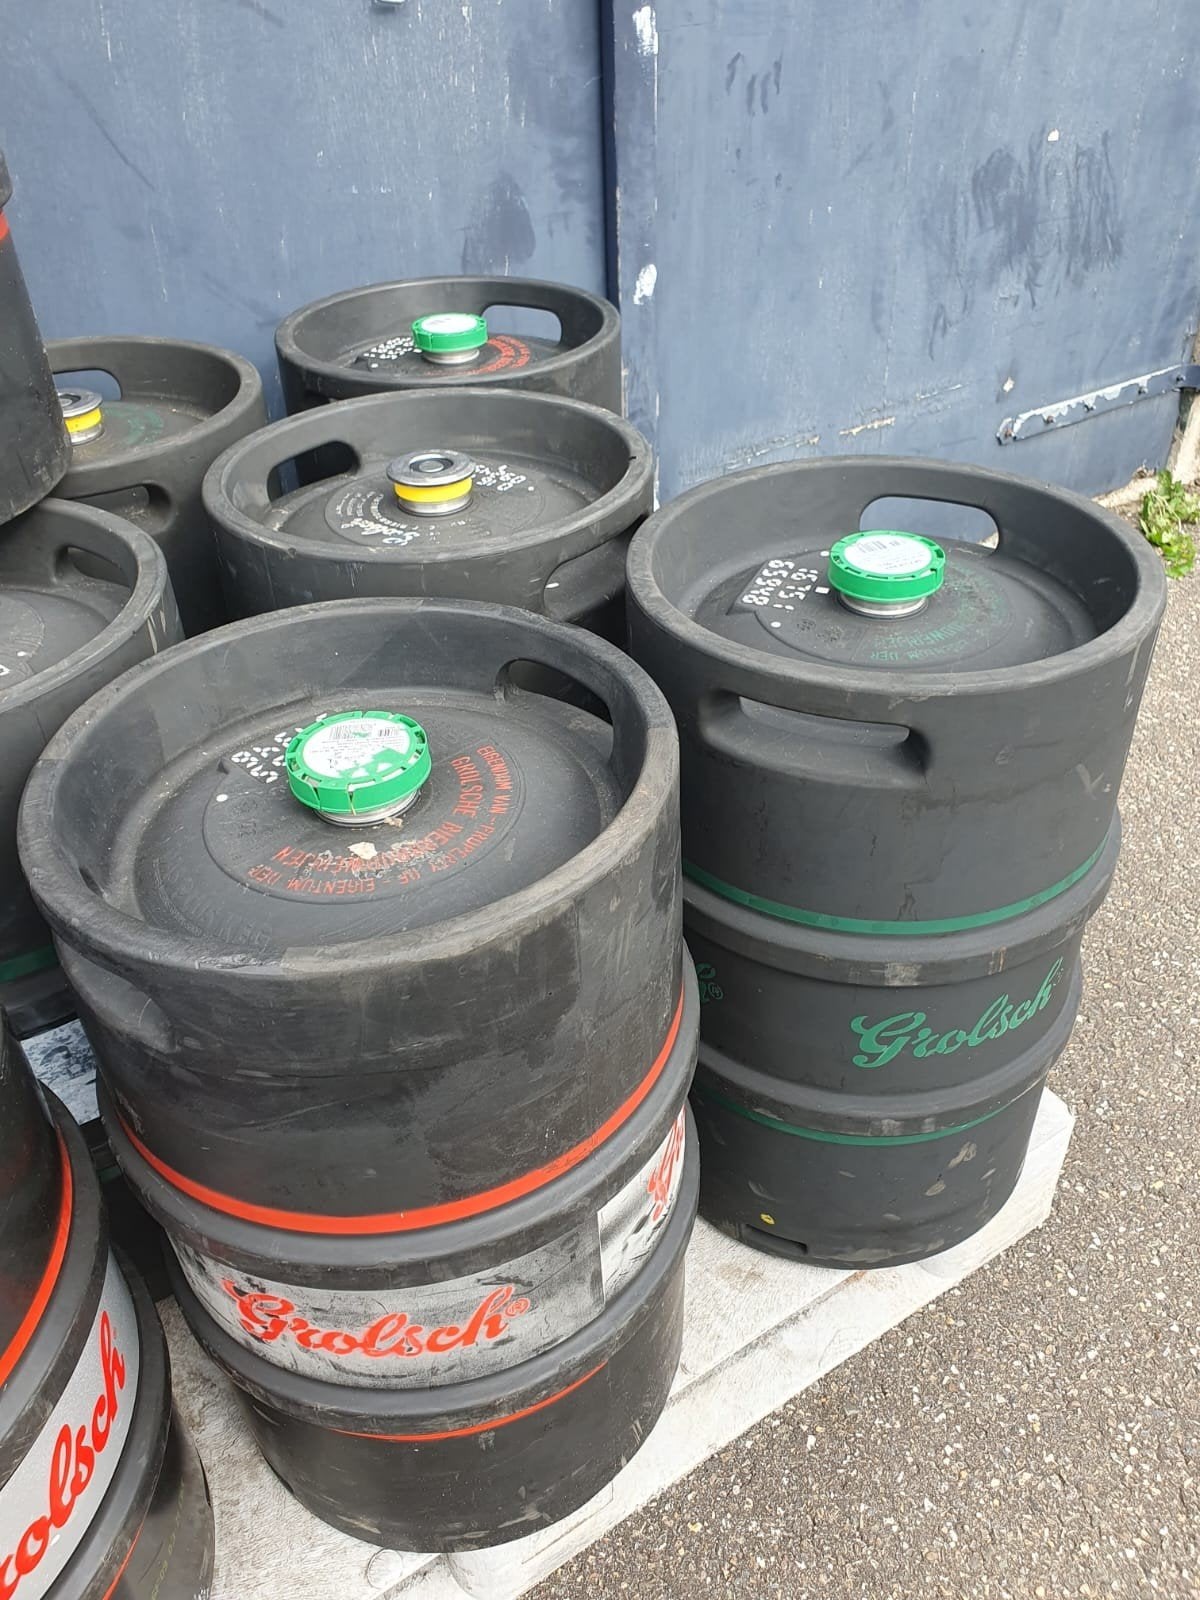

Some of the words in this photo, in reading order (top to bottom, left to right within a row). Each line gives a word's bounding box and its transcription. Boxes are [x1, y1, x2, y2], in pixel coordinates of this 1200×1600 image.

[450, 755, 484, 818] GROLSCHE
[489, 794, 513, 815] VAN
[850, 956, 1064, 1069] Grolsch
[221, 1278, 517, 1358] Grolsch
